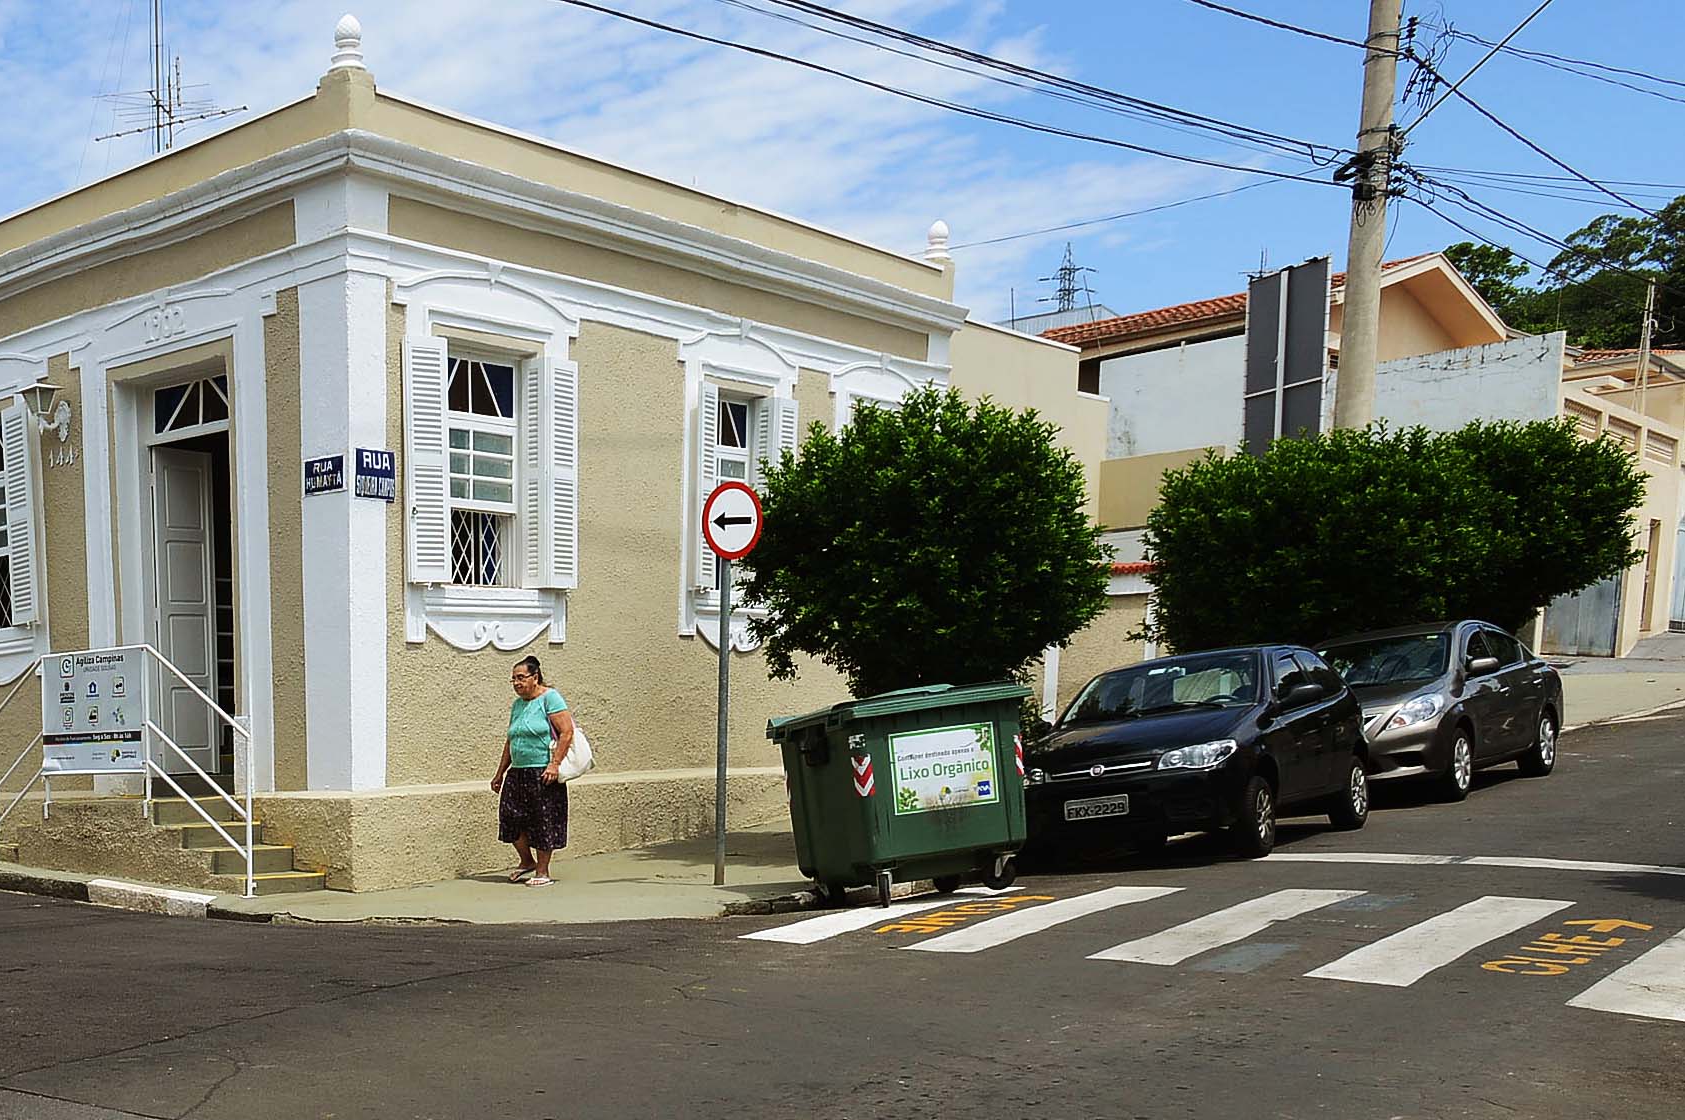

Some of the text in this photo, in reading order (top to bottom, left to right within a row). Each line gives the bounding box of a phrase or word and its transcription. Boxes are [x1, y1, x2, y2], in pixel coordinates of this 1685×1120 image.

[312, 460, 333, 474] RUA
[362, 451, 391, 471] RUA
[75, 654, 124, 668] Agiliza Campinas
[900, 758, 989, 781] Lixo Orgânico
[1480, 932, 1626, 976] OLHE
